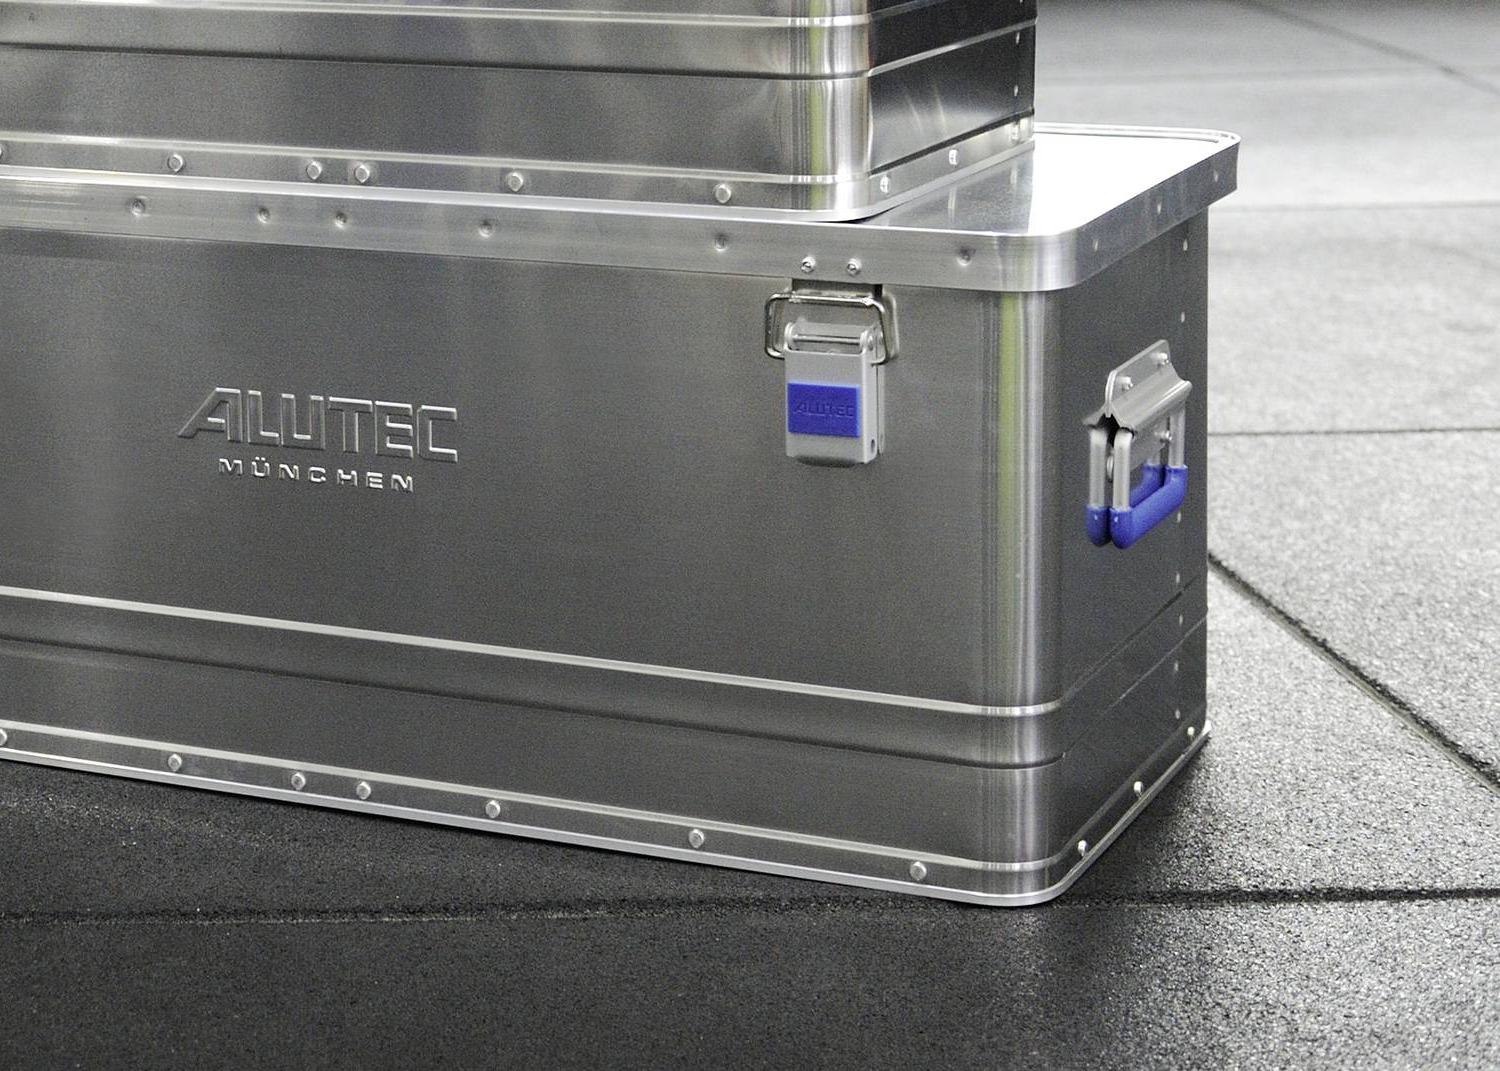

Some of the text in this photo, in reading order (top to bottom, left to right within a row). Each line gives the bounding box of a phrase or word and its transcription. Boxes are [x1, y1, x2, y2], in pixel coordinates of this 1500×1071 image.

[177, 385, 459, 464] ALUTEC
[793, 400, 855, 419] ALUTEC
[218, 456, 414, 494] MÜNCHEN
